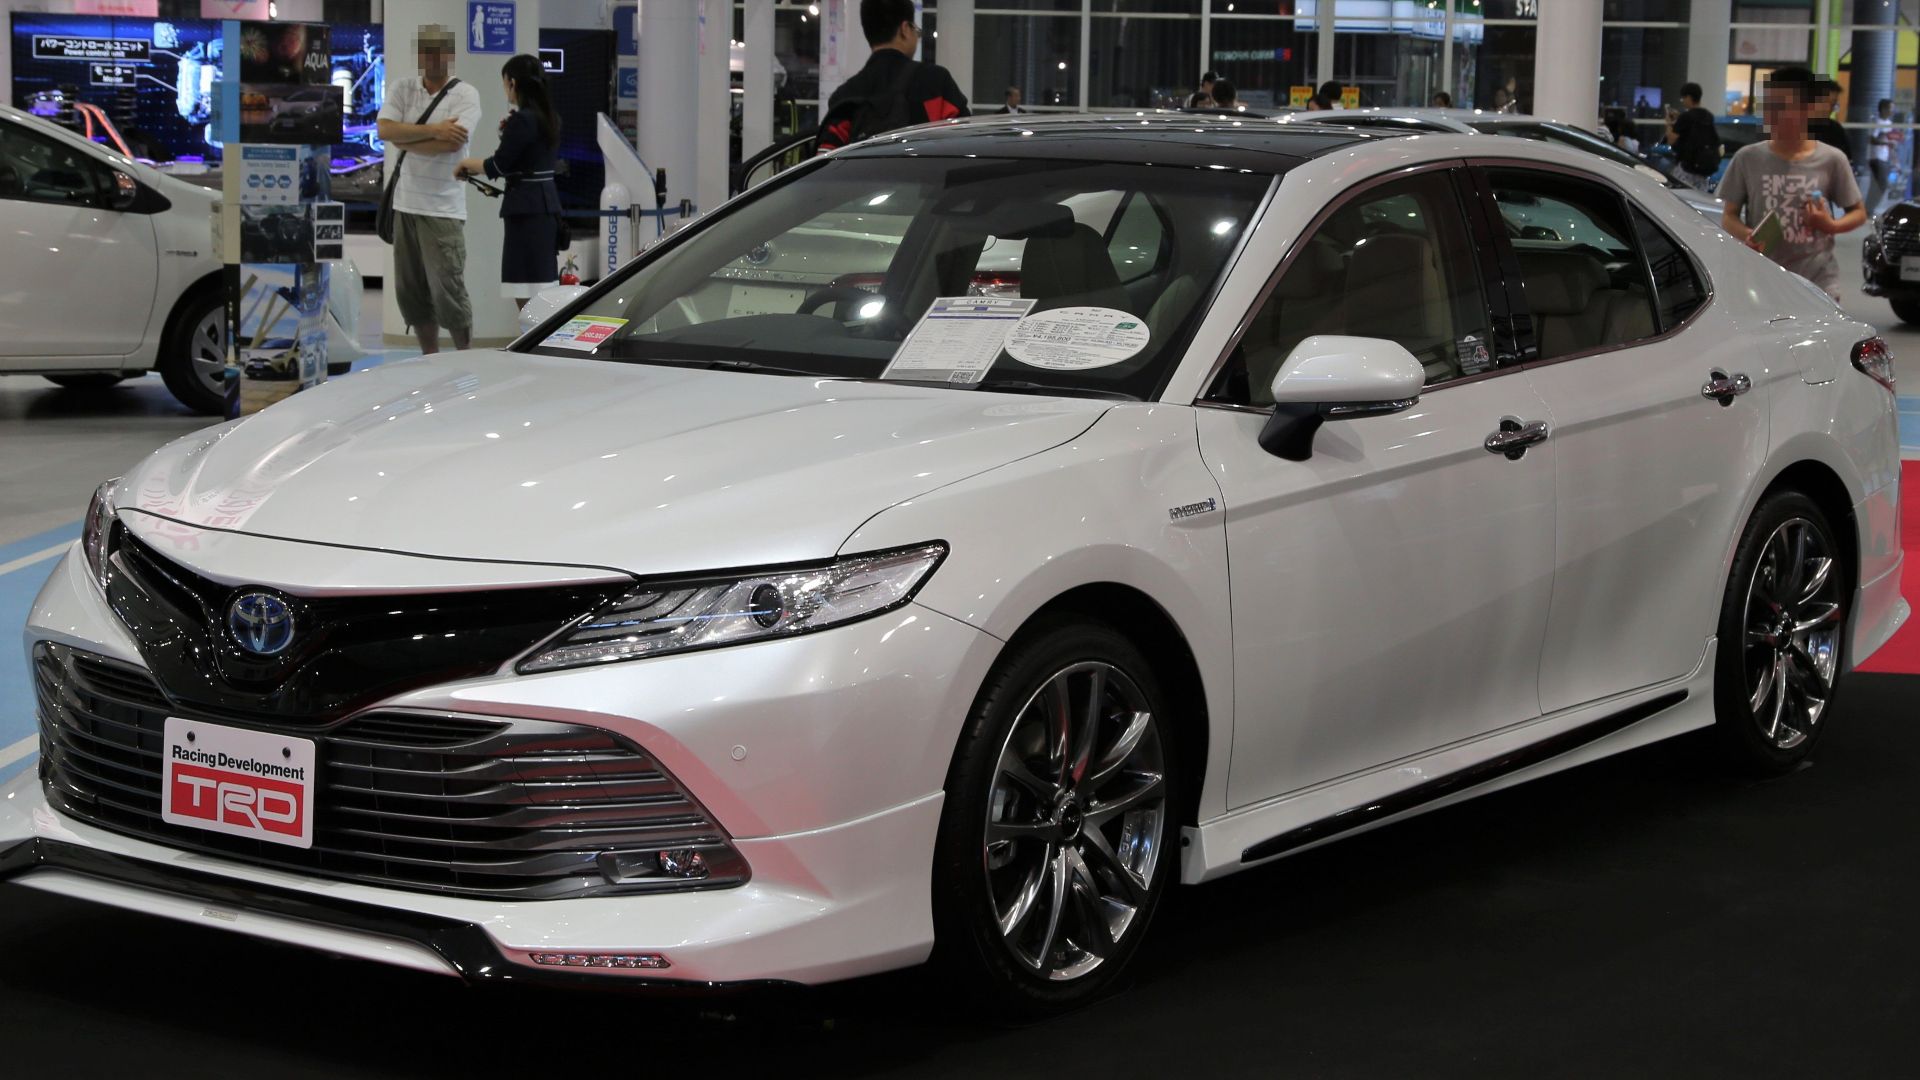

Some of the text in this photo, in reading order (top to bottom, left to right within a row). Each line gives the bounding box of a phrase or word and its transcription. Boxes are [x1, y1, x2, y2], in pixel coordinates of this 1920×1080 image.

[40, 39, 144, 51] パワーコントロールユニット
[304, 53, 328, 71] AQUA
[172, 745, 305, 781] Racing Development
[177, 773, 297, 831] TRD
